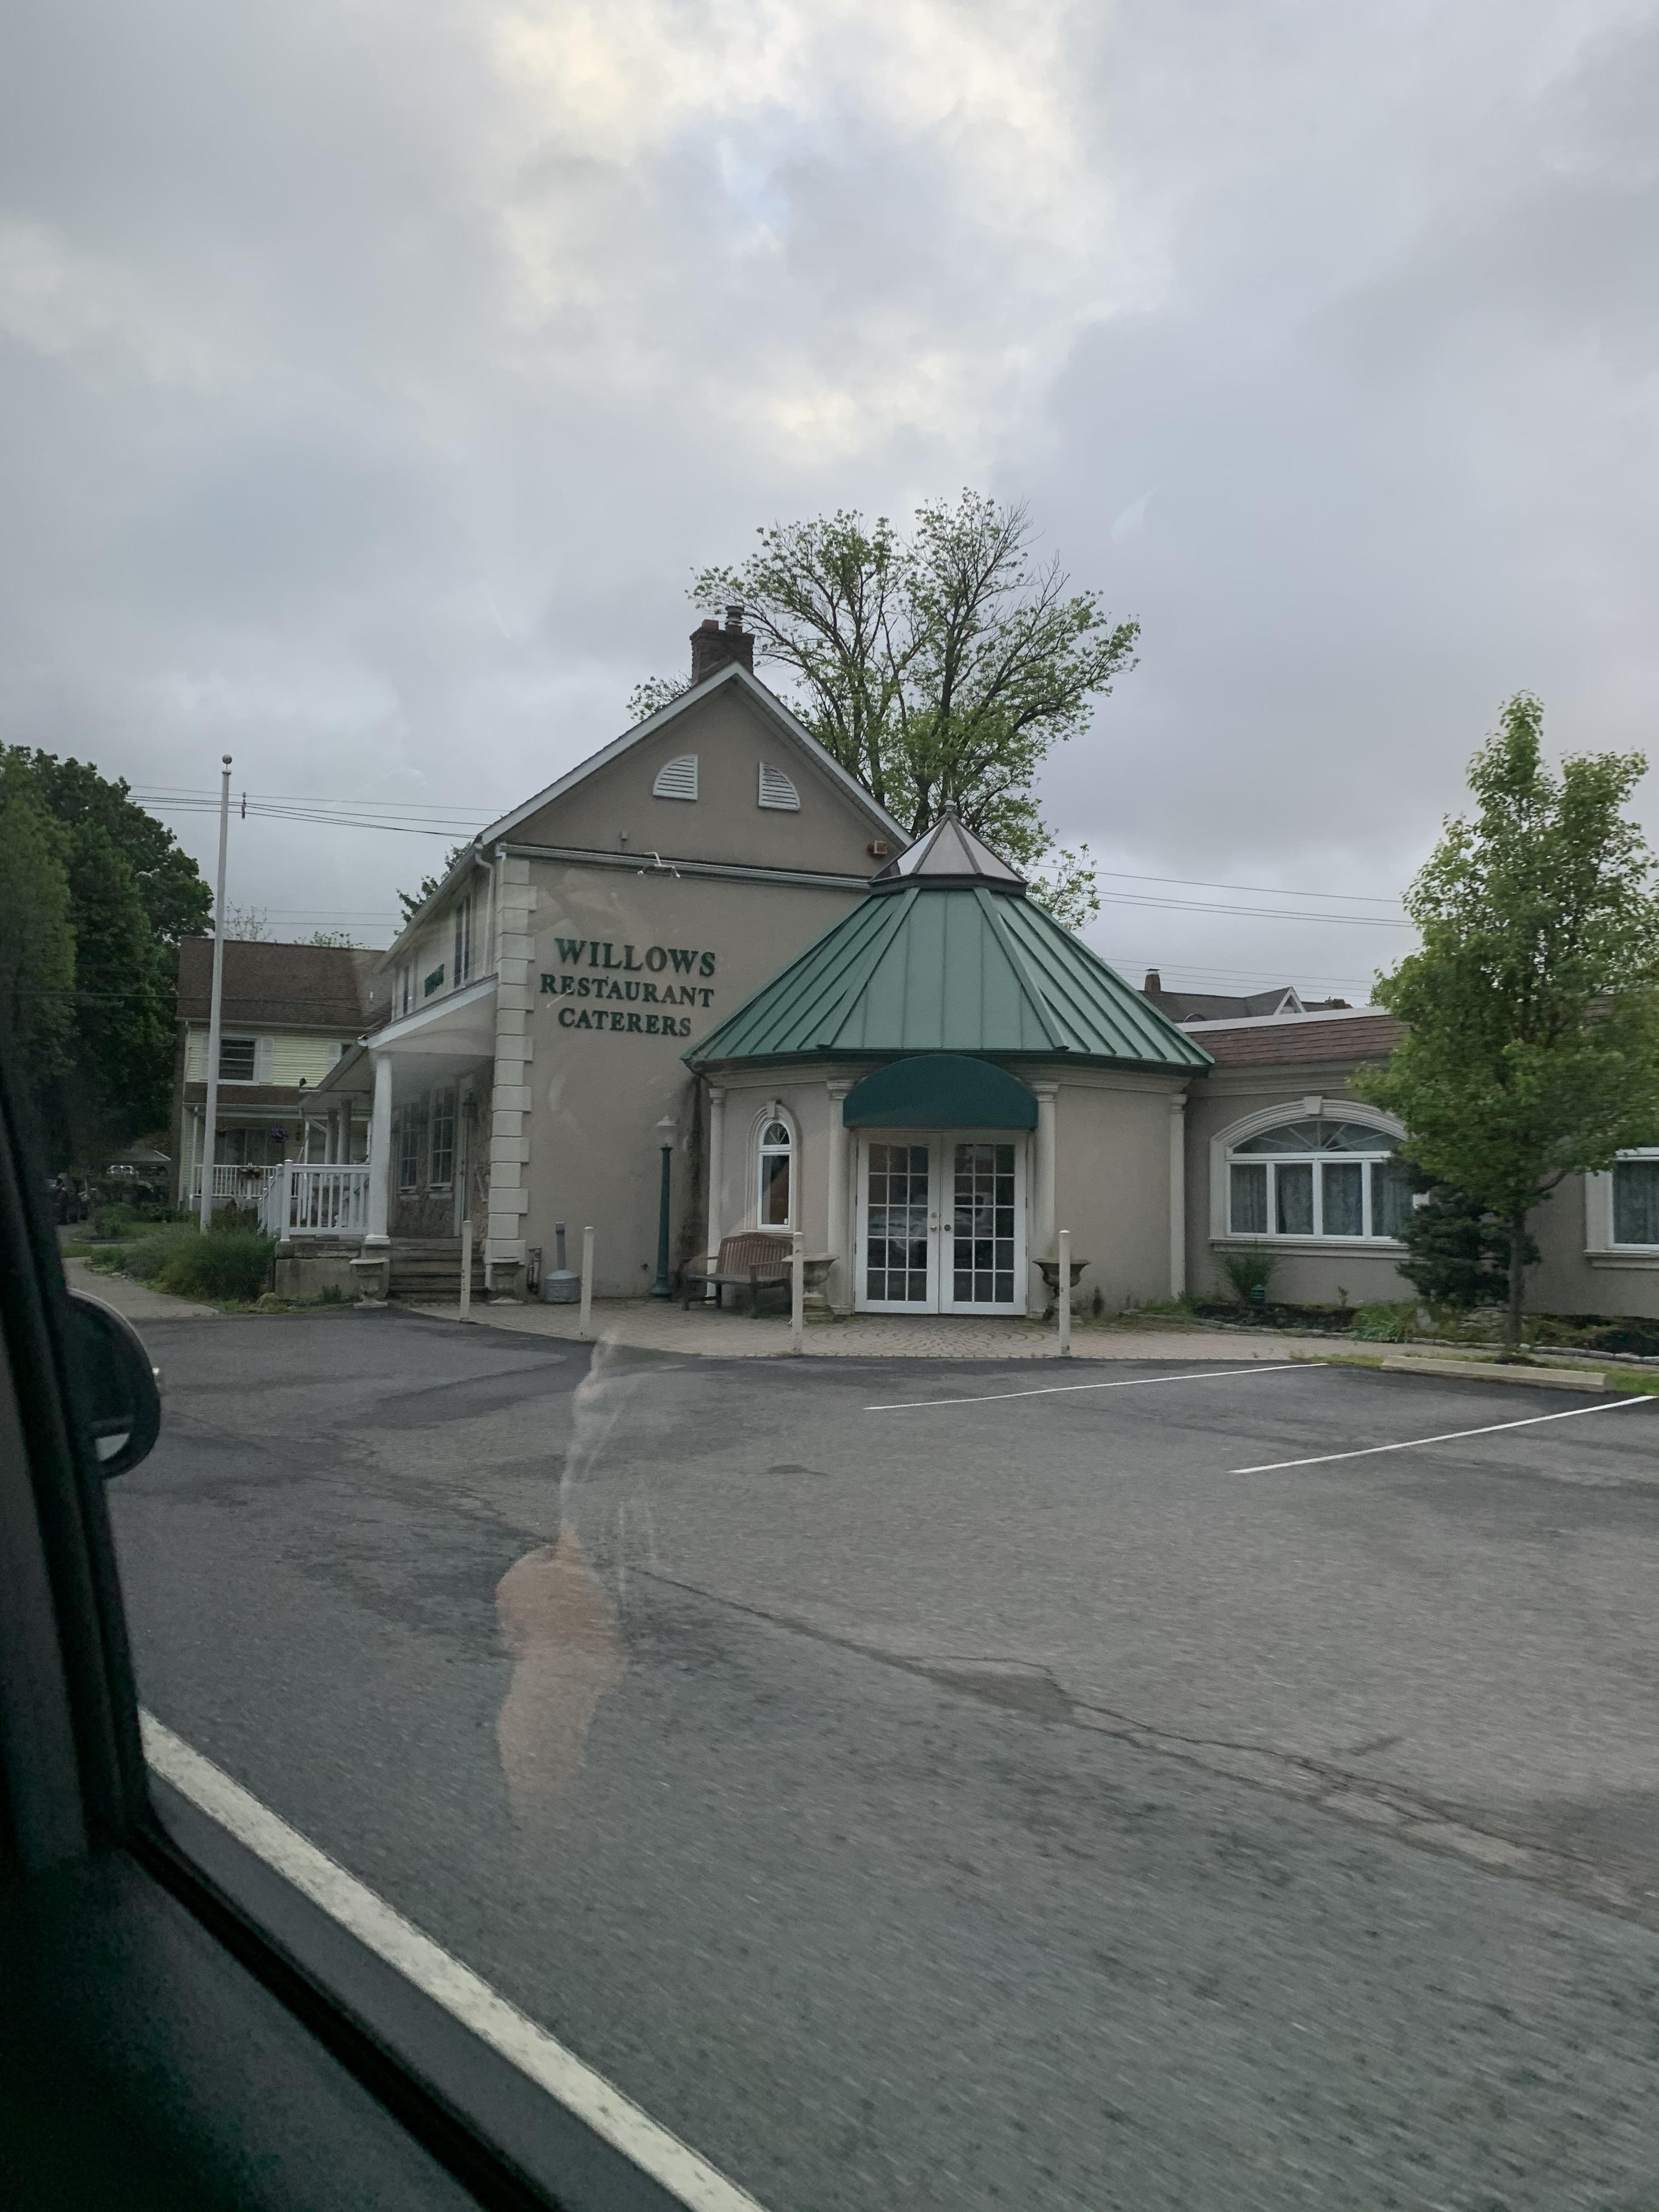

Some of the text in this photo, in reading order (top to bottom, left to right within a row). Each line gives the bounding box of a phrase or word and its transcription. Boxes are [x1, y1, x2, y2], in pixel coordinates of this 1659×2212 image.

[555, 938, 715, 977] WILLOWS
[540, 973, 714, 1007] RESTAURANT
[558, 1007, 691, 1036] CATERERS
